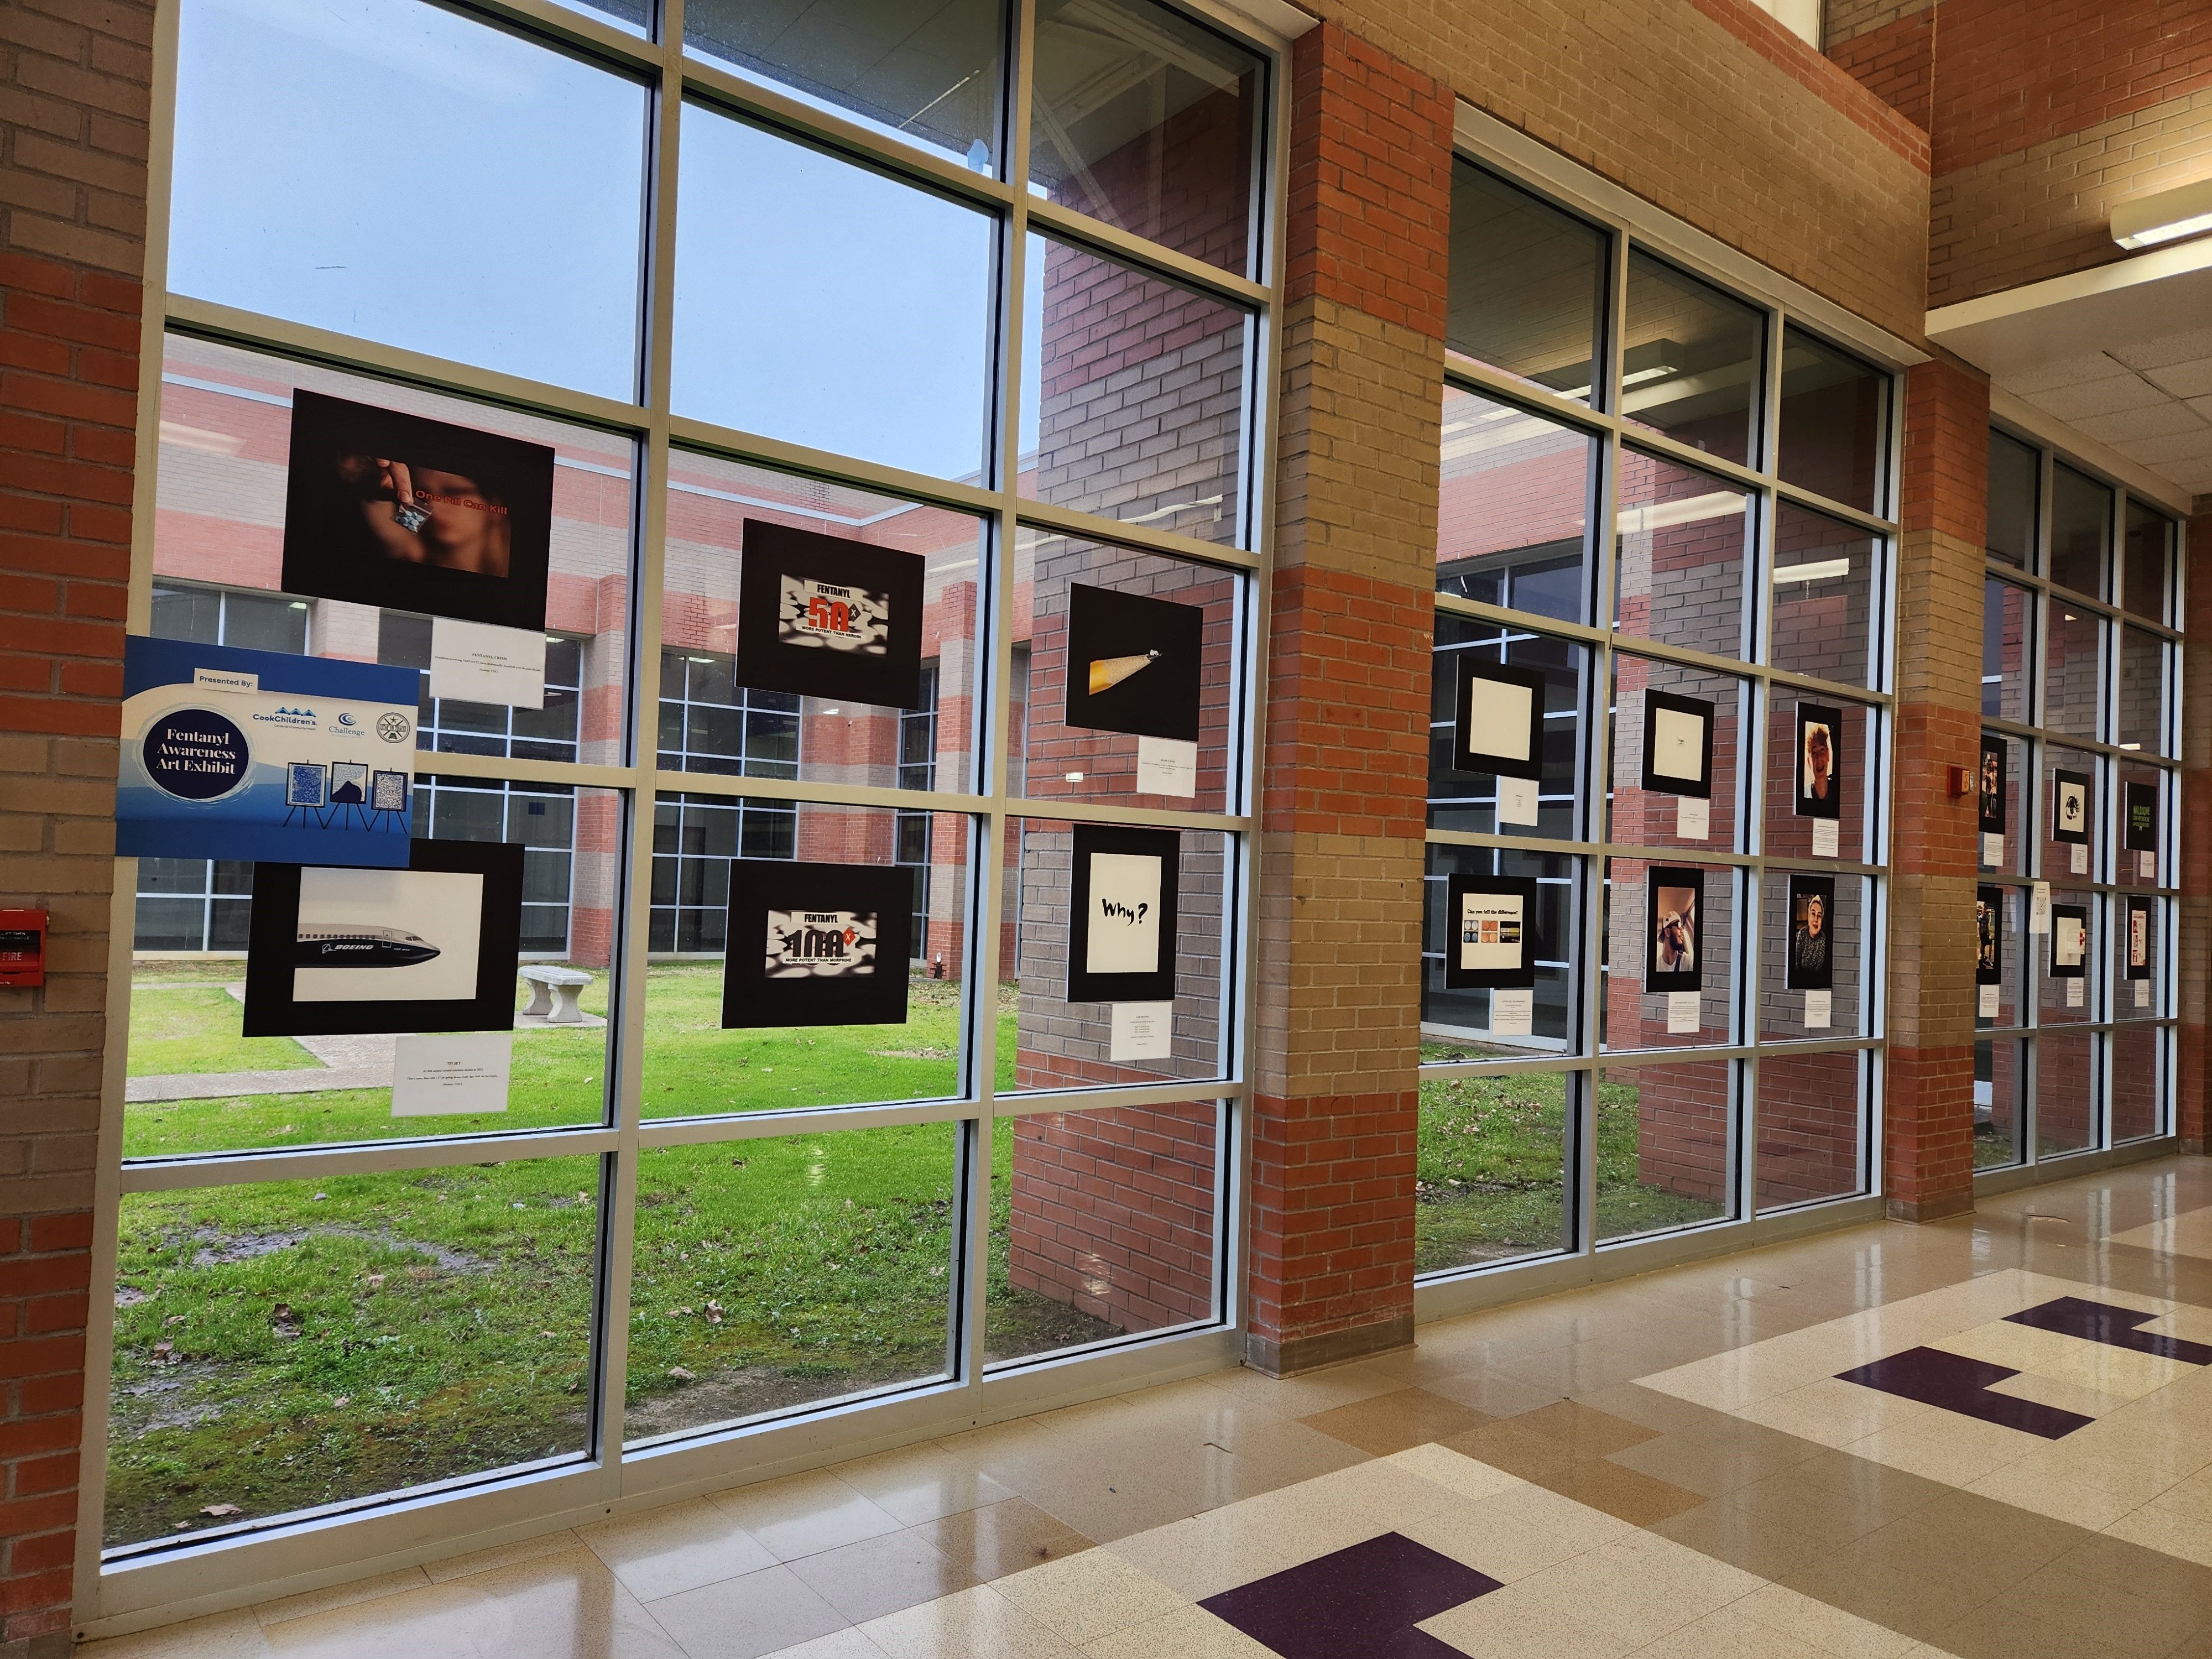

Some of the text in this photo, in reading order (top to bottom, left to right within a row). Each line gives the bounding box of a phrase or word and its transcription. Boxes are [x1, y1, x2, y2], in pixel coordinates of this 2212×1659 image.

[415, 491, 508, 515] One Pill Can Kill
[817, 584, 851, 598] FENTANYL
[200, 676, 239, 685] Presented
[167, 728, 229, 746] Fentanyl
[328, 726, 365, 737] Challenge
[157, 743, 236, 760] Awareness
[156, 758, 236, 775] Art Exhibit
[804, 914, 838, 923] FENTANYL
[2, 952, 22, 961] FIRE
